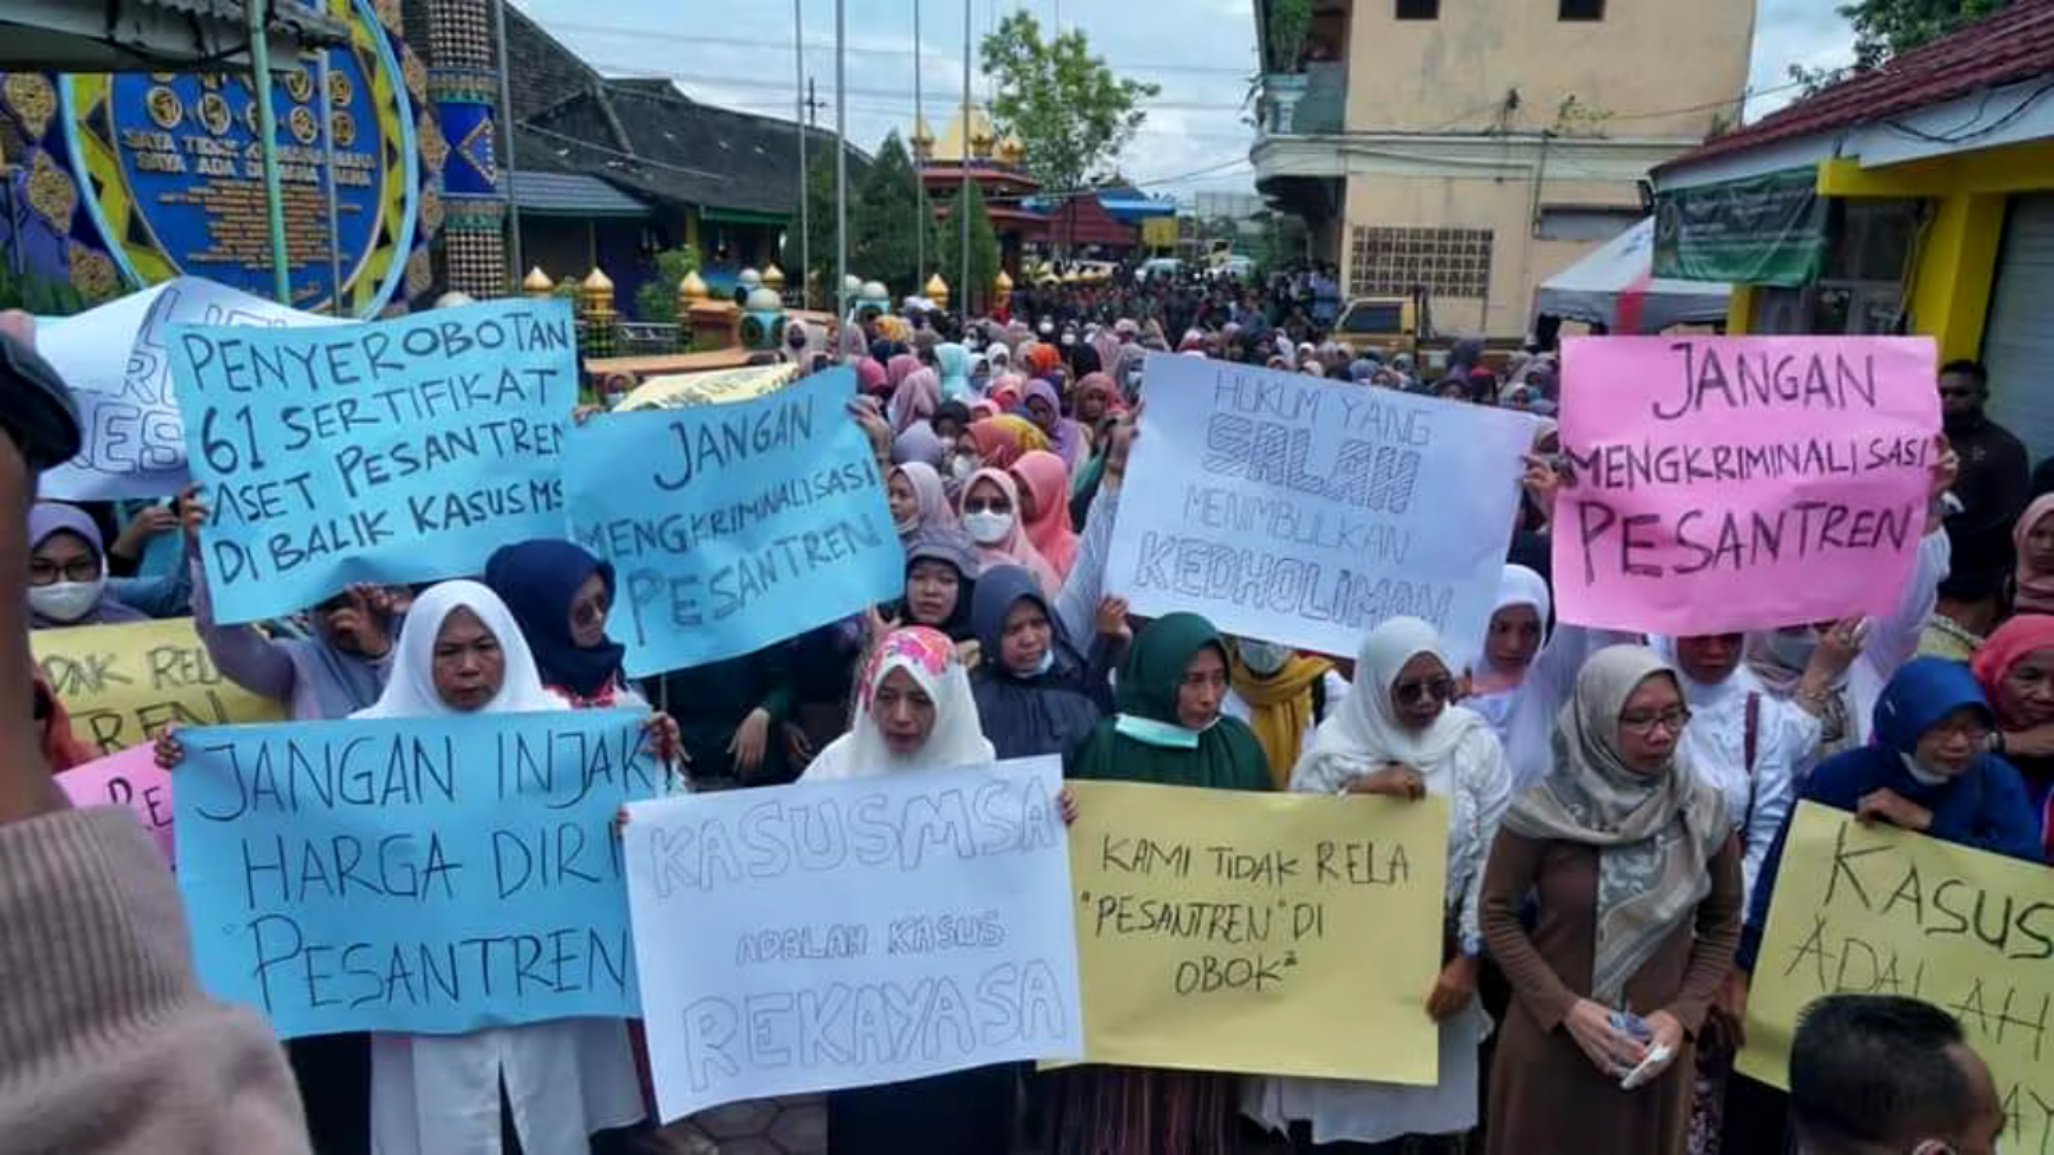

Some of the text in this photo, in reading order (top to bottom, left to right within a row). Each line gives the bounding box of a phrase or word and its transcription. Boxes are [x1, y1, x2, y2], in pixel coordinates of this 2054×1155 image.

[182, 311, 569, 393] PENYEROBOTAN
[1652, 341, 1877, 421] JANGAN
[201, 404, 266, 475] 61
[280, 368, 558, 452] SERTIFIKAT
[653, 393, 813, 491] JANGAN
[1215, 369, 1434, 447] HUKUM YANG
[211, 472, 315, 527] ASET
[1201, 412, 1422, 515] SALAH
[1566, 437, 1929, 492] MENGKRIMINALISASI
[213, 539, 259, 585] DI
[268, 510, 394, 573] BALIK
[577, 458, 877, 557] MENGKRIMINALISASI
[1184, 485, 1411, 566] MENIMBULKAN
[1577, 500, 1913, 586] PESANTREN
[625, 513, 884, 647] PESANTREN
[196, 731, 456, 822] JANGAN
[499, 729, 655, 810] INJAK
[242, 820, 623, 909] HARGA DIRI
[1102, 834, 1191, 877] KAMI
[1316, 840, 1410, 886] RELA
[1824, 821, 2054, 961] KASUS
[735, 912, 1005, 967] ADALAH KASUS
[1294, 903, 1324, 938] DI
[683, 960, 1067, 1093] REKAYASA
